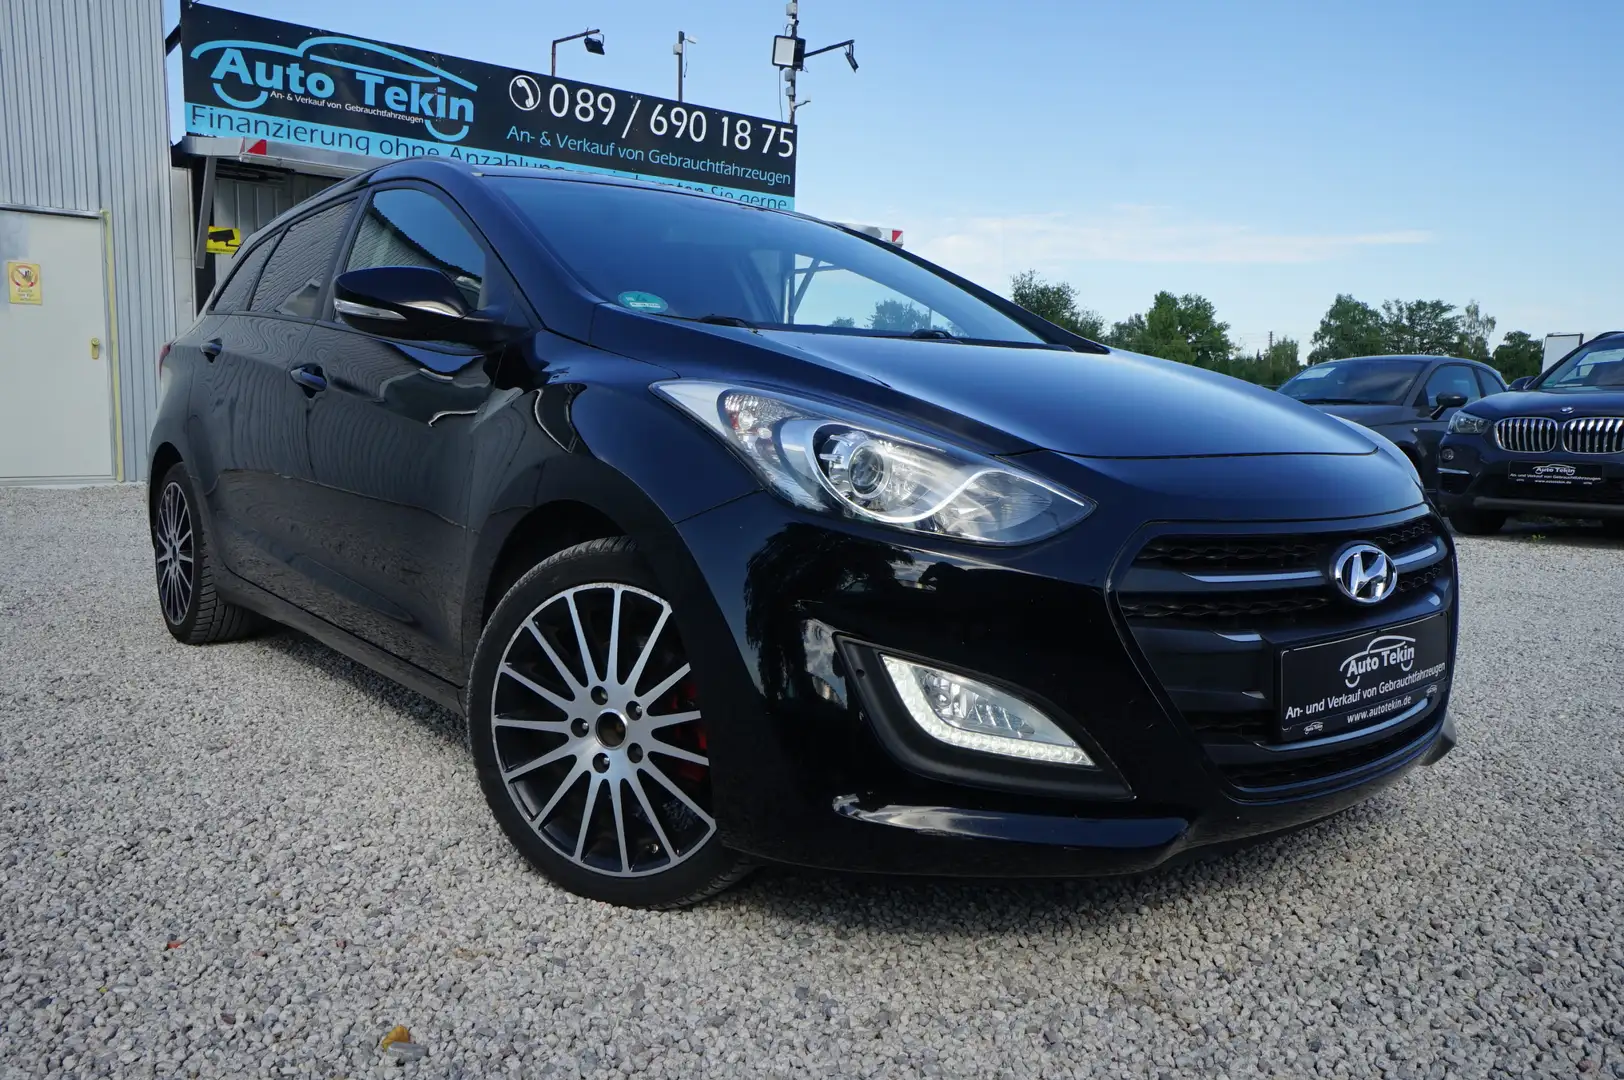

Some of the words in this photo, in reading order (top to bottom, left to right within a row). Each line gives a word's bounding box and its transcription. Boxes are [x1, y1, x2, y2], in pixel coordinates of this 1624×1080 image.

[210, 48, 335, 98] Auto
[355, 72, 474, 123] Tekin
[270, 90, 285, 100] An-
[286, 93, 293, 101] &
[294, 95, 326, 107] Verkauf
[326, 101, 342, 110] von
[344, 103, 424, 124] Gebrauchtfahrzeugen
[191, 105, 371, 155] Finanzierung
[379, 137, 440, 158] ohne
[450, 147, 565, 170] Anzahl
[549, 83, 616, 126] 089
[649, 103, 707, 143] 690
[721, 115, 752, 151] 18
[761, 123, 794, 158] 75
[506, 125, 536, 143] An-
[539, 133, 551, 147] &
[556, 133, 617, 157] Verkauf
[618, 146, 645, 162] von
[648, 149, 791, 187] Gebrauchtfahrzeugen
[1285, 706, 1303, 720] An-
[1305, 699, 1325, 715] und
[1327, 688, 1361, 709] Verkauf
[1362, 686, 1377, 699] von
[1379, 661, 1446, 694] Gebrauchtfahrzeugen
[1347, 657, 1379, 677] Auto
[1381, 646, 1415, 666] Tekin
[1347, 695, 1412, 724] www.autotekin.de
